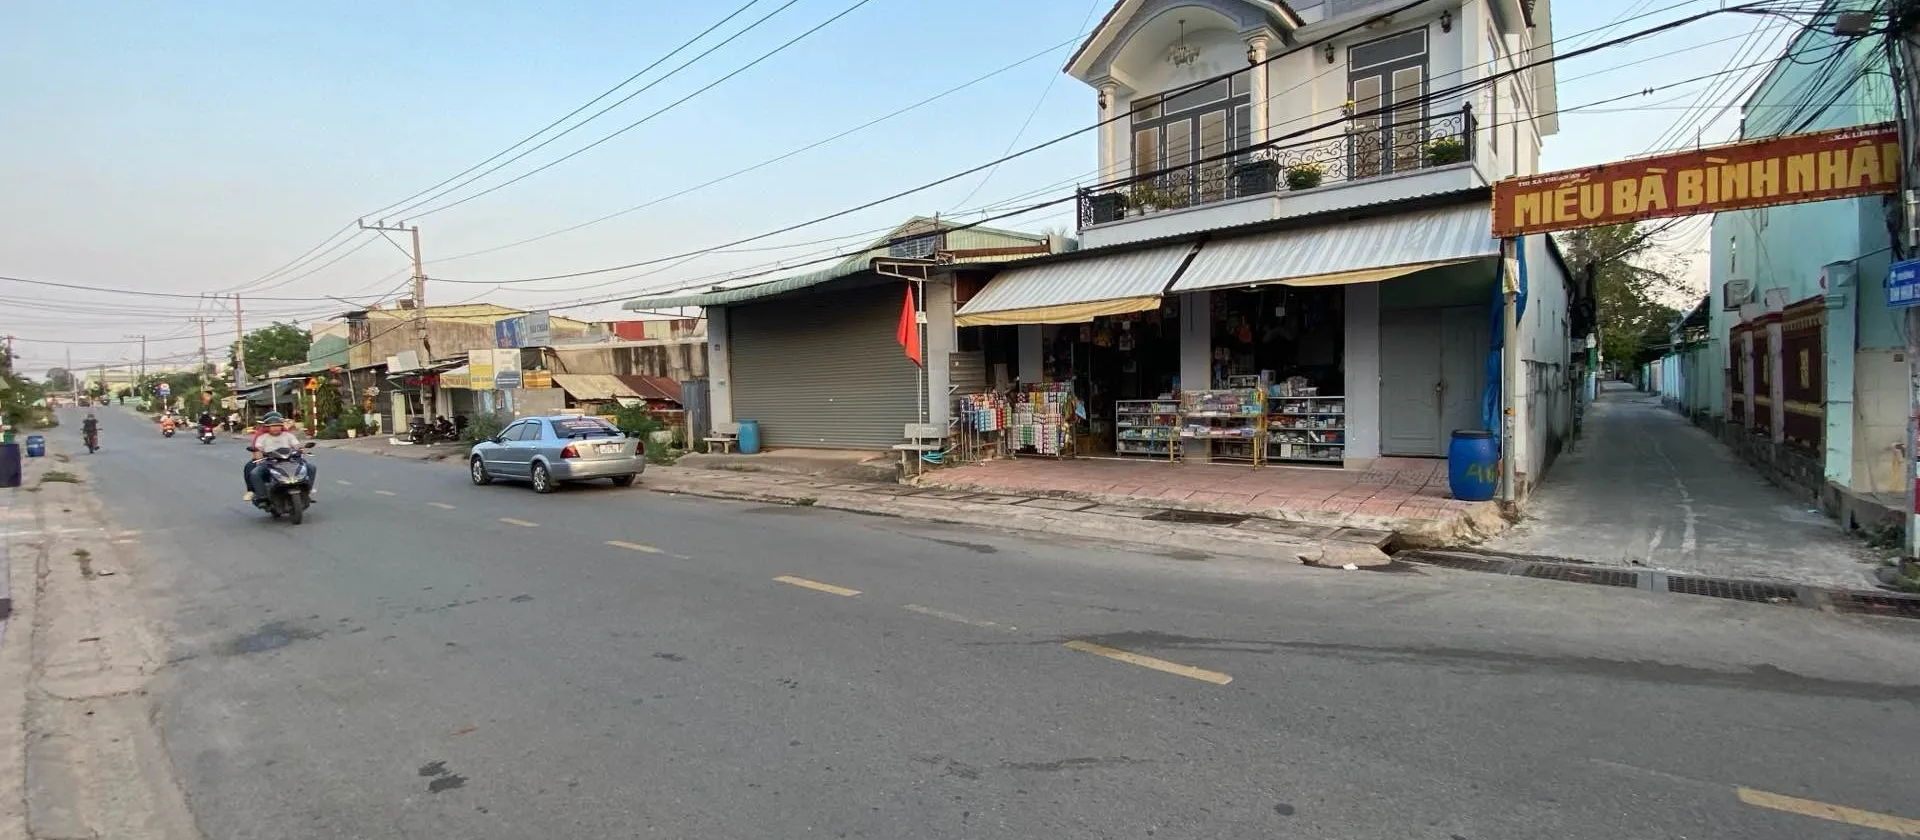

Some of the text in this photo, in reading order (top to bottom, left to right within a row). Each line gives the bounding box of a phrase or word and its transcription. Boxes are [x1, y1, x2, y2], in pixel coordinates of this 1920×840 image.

[1514, 173, 1605, 228] MIỄU
[1612, 167, 1668, 215] BÀ
[1677, 156, 1781, 207] BÌNH
